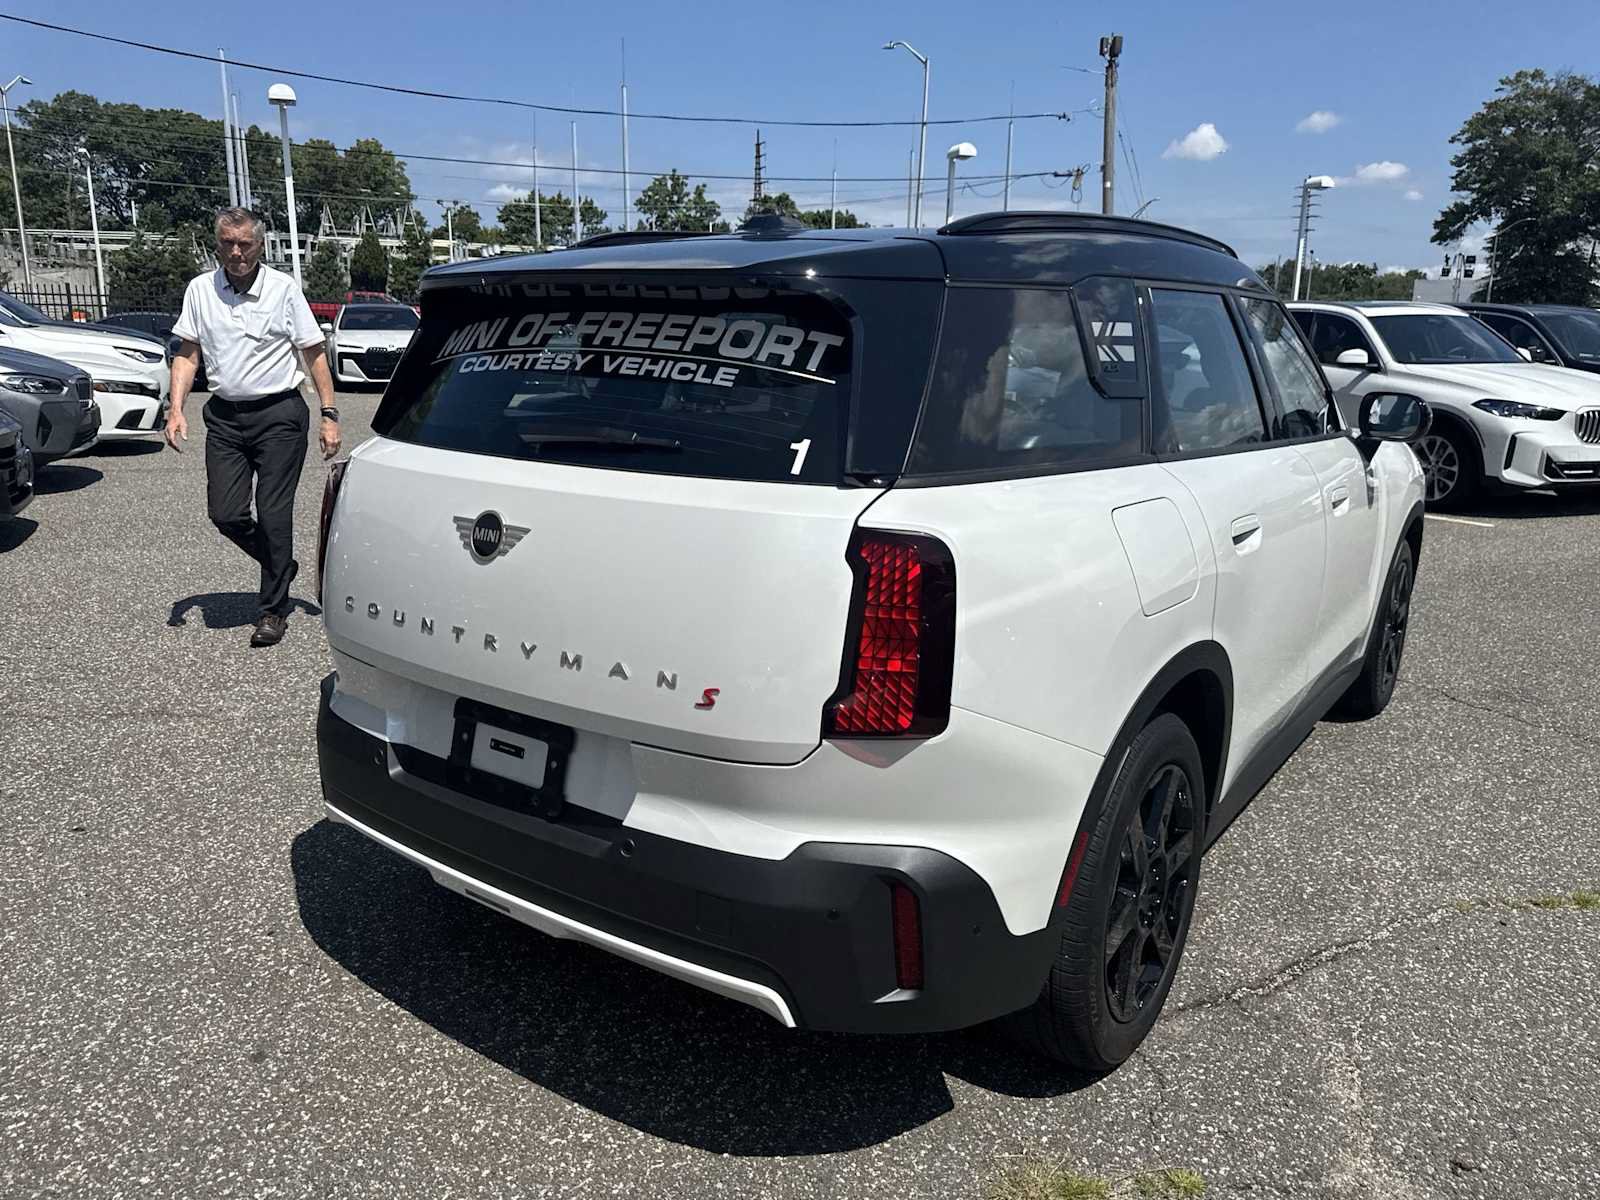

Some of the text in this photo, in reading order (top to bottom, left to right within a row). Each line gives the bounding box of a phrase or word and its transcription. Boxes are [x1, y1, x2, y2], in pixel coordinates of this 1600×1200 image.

[437, 311, 845, 372] MINI OF FREEPORT
[458, 353, 740, 388] COURTESY VEHICLE
[786, 438, 812, 476] 1
[473, 526, 501, 544] MINI
[344, 595, 721, 711] COUNTRYMAN S
